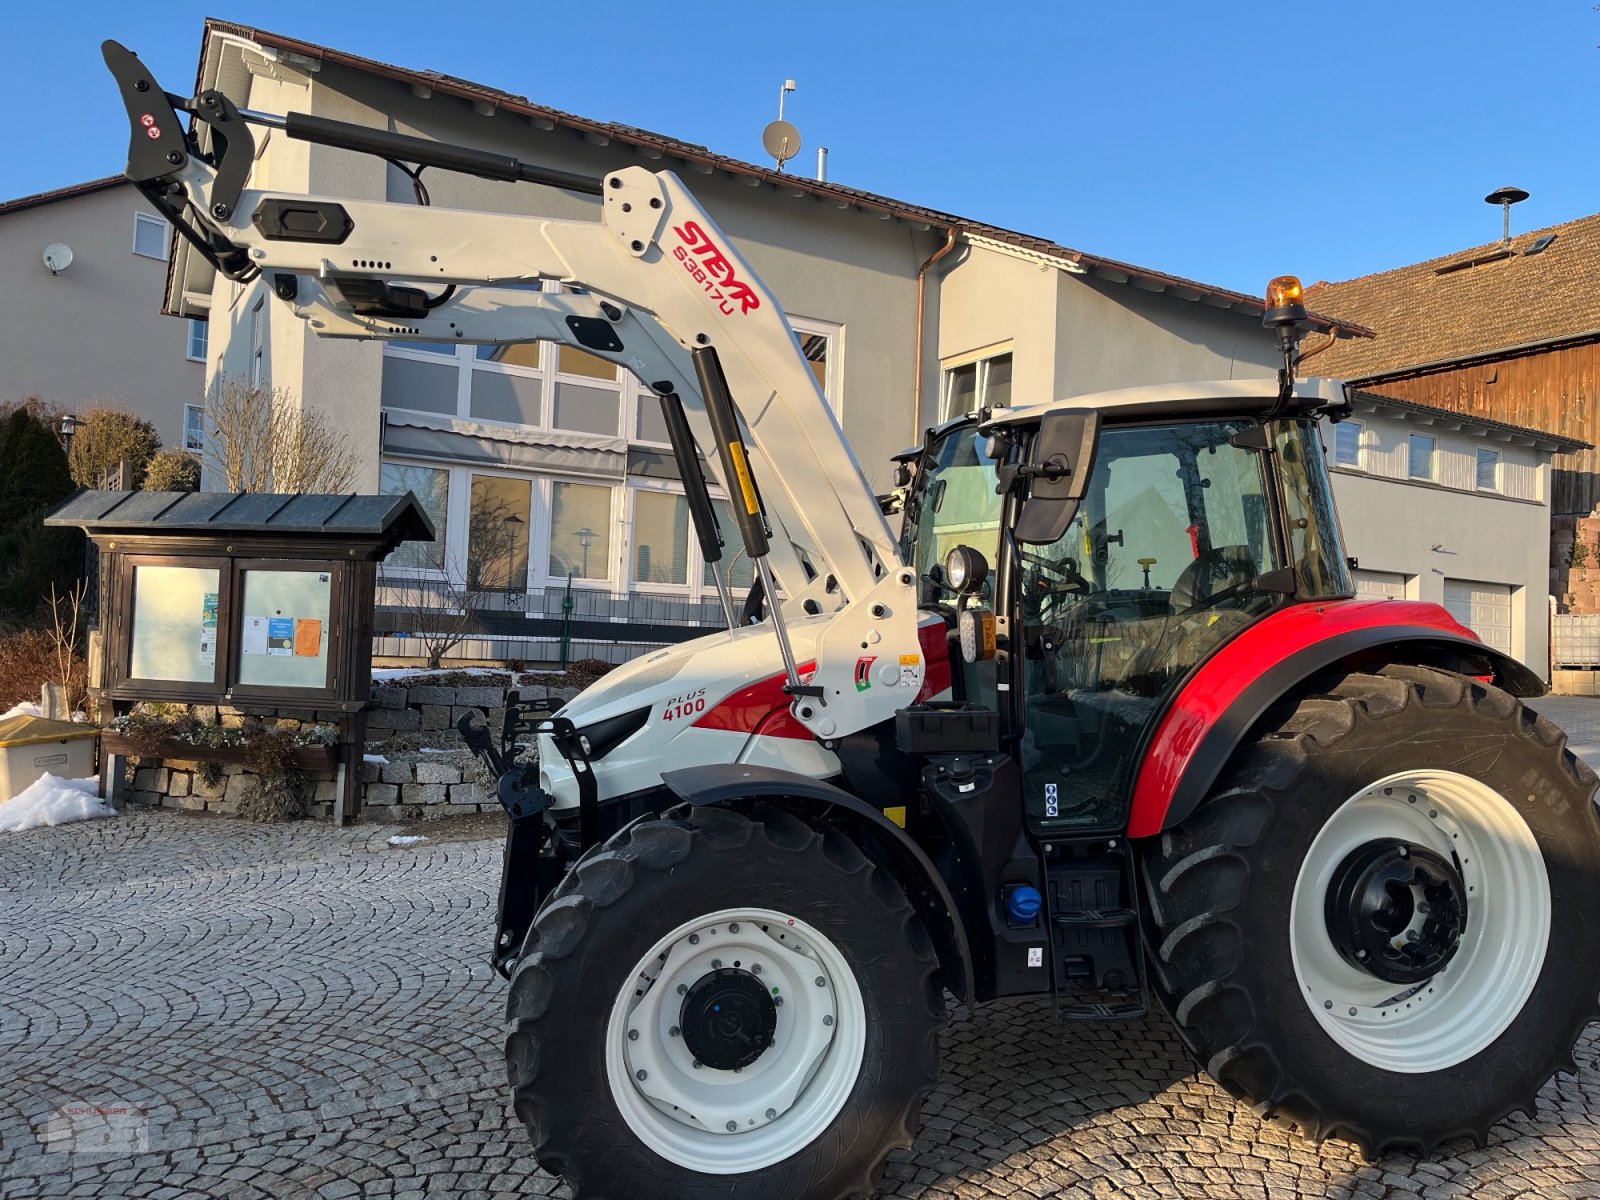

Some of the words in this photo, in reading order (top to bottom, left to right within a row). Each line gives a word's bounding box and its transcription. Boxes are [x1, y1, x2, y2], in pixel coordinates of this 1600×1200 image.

[673, 221, 760, 315] STEYR
[673, 246, 734, 315] S3817U
[663, 698, 705, 721] 4100
[667, 687, 706, 707] PLUS
